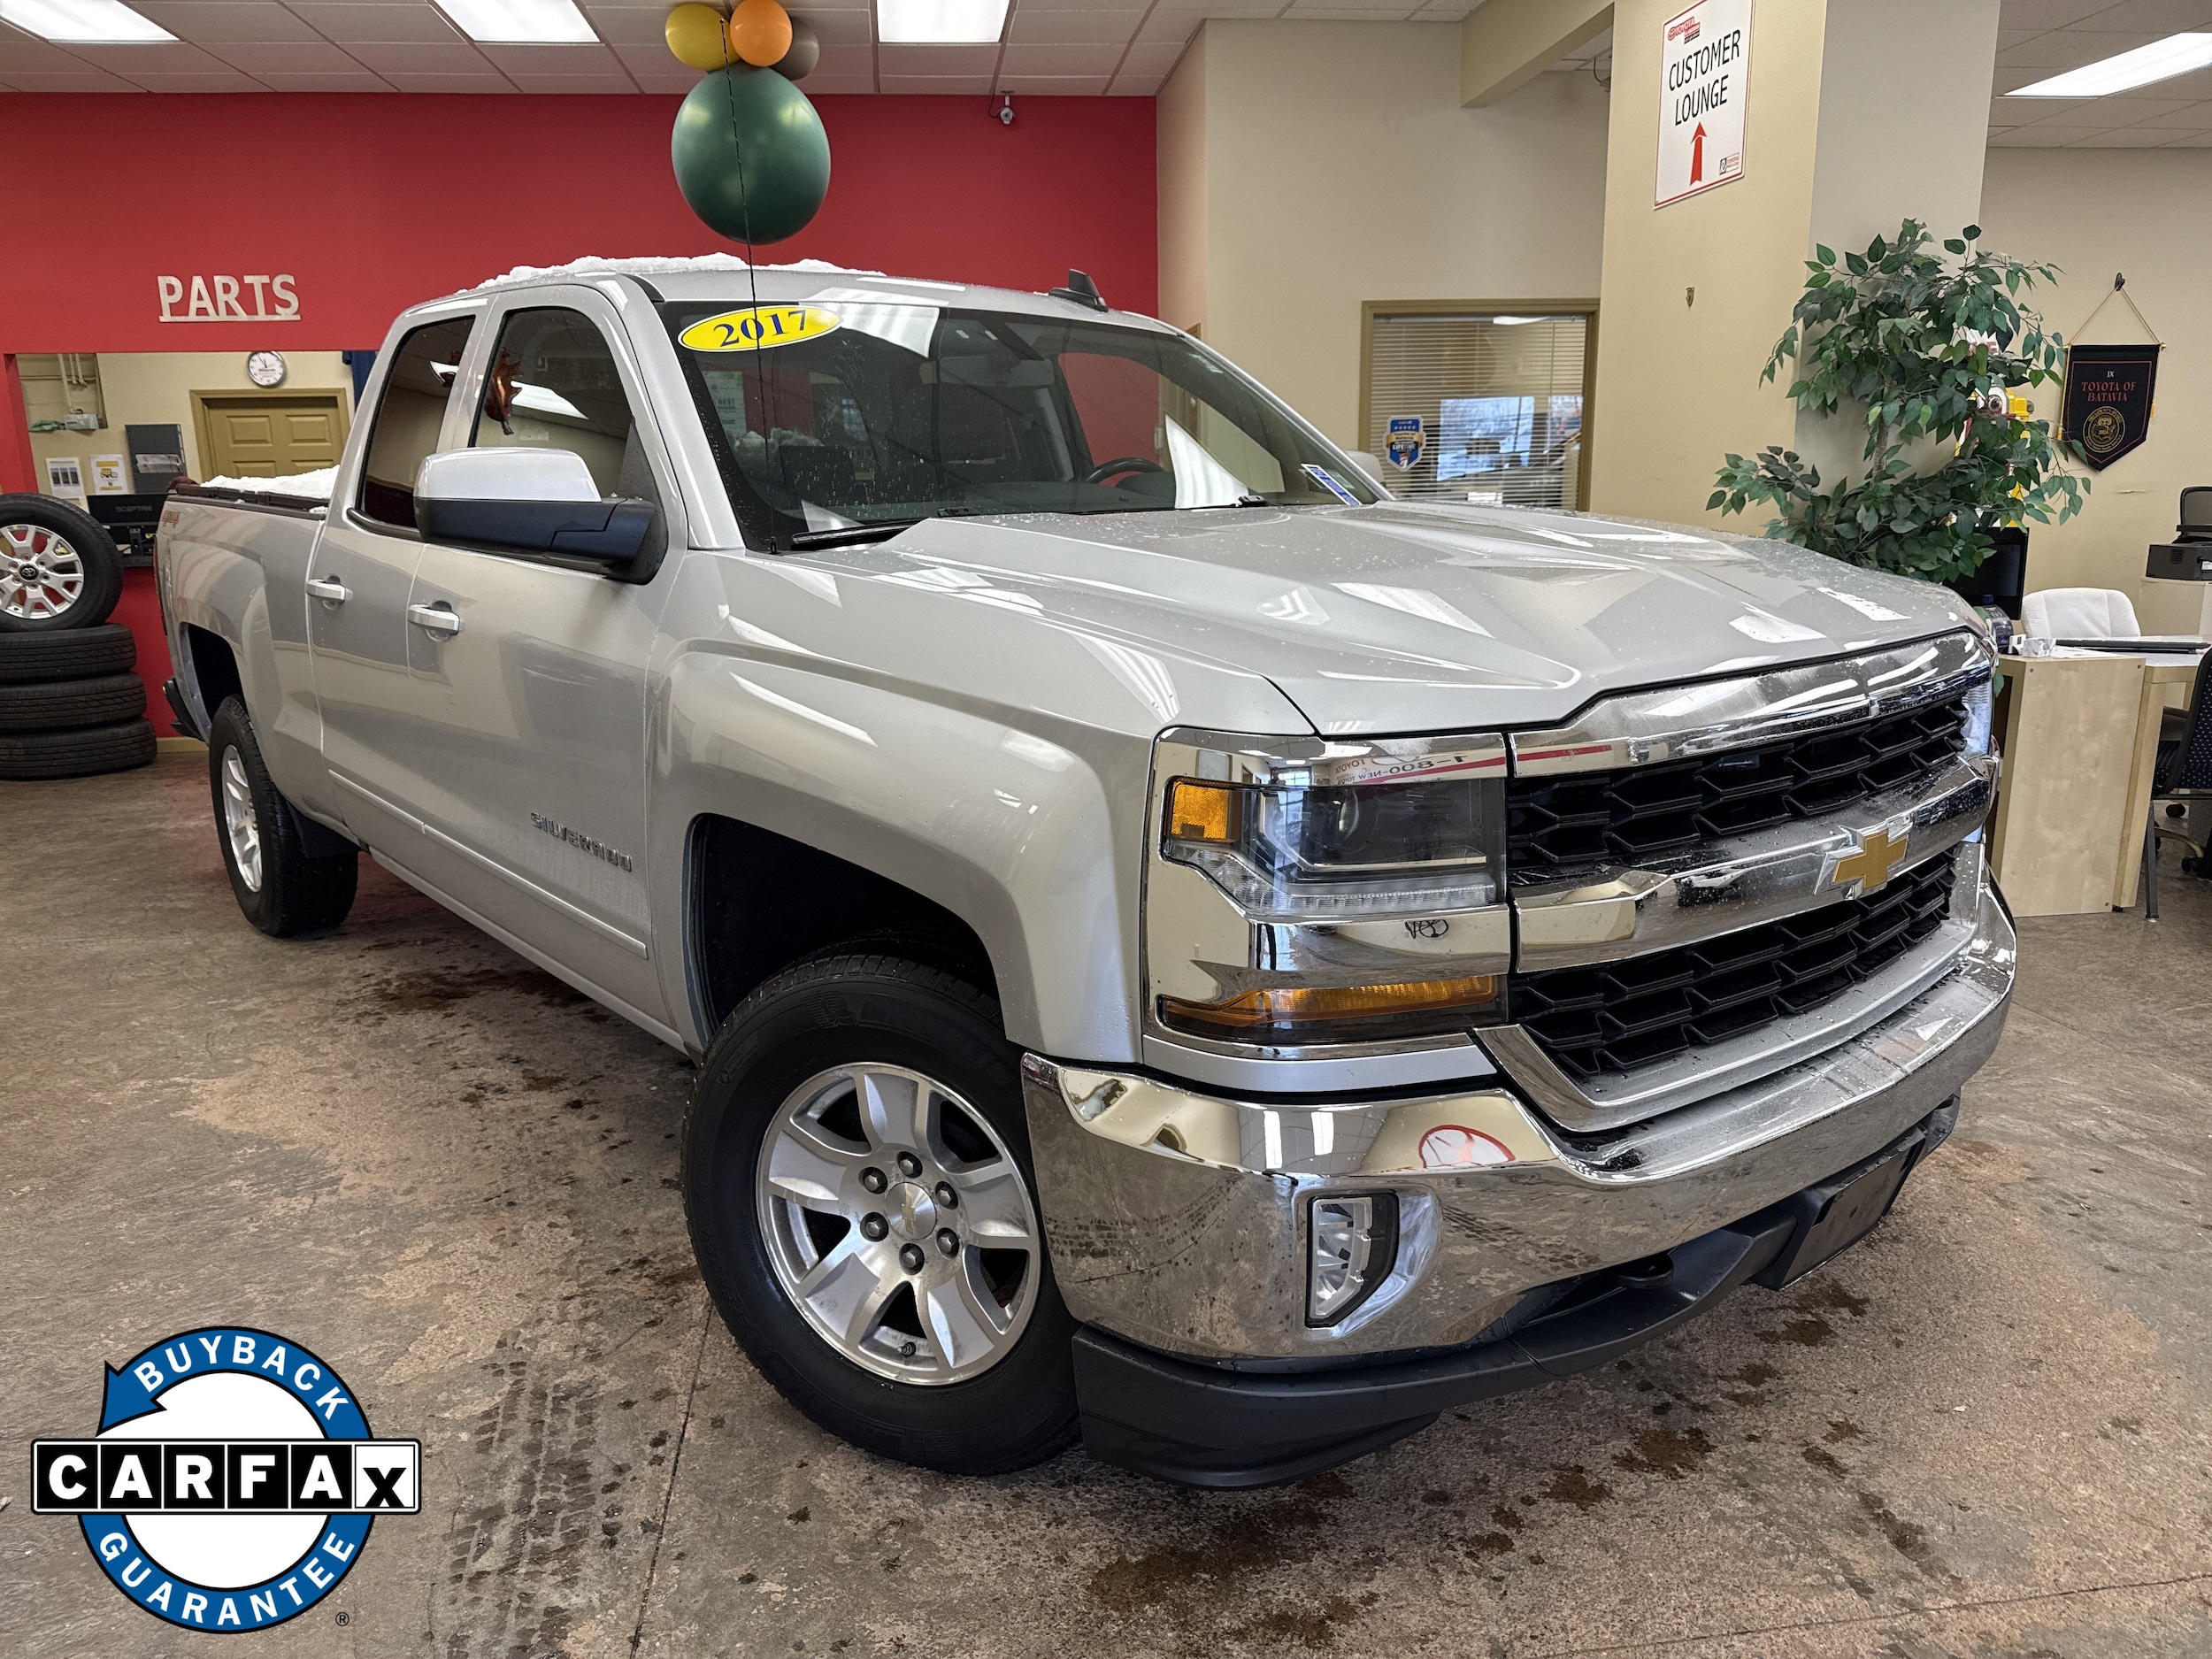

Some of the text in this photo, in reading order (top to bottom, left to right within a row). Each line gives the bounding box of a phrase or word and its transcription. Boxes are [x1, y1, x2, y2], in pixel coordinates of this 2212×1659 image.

[1669, 29, 1741, 91] CUSTOMER
[1675, 74, 1729, 127] LOUNGE
[157, 273, 302, 322] PARTS
[713, 309, 808, 348] 2017
[2081, 381, 2138, 392] TOYOTA OF
[2087, 392, 2128, 402] BATAVIA
[531, 810, 633, 873] SILVERADO
